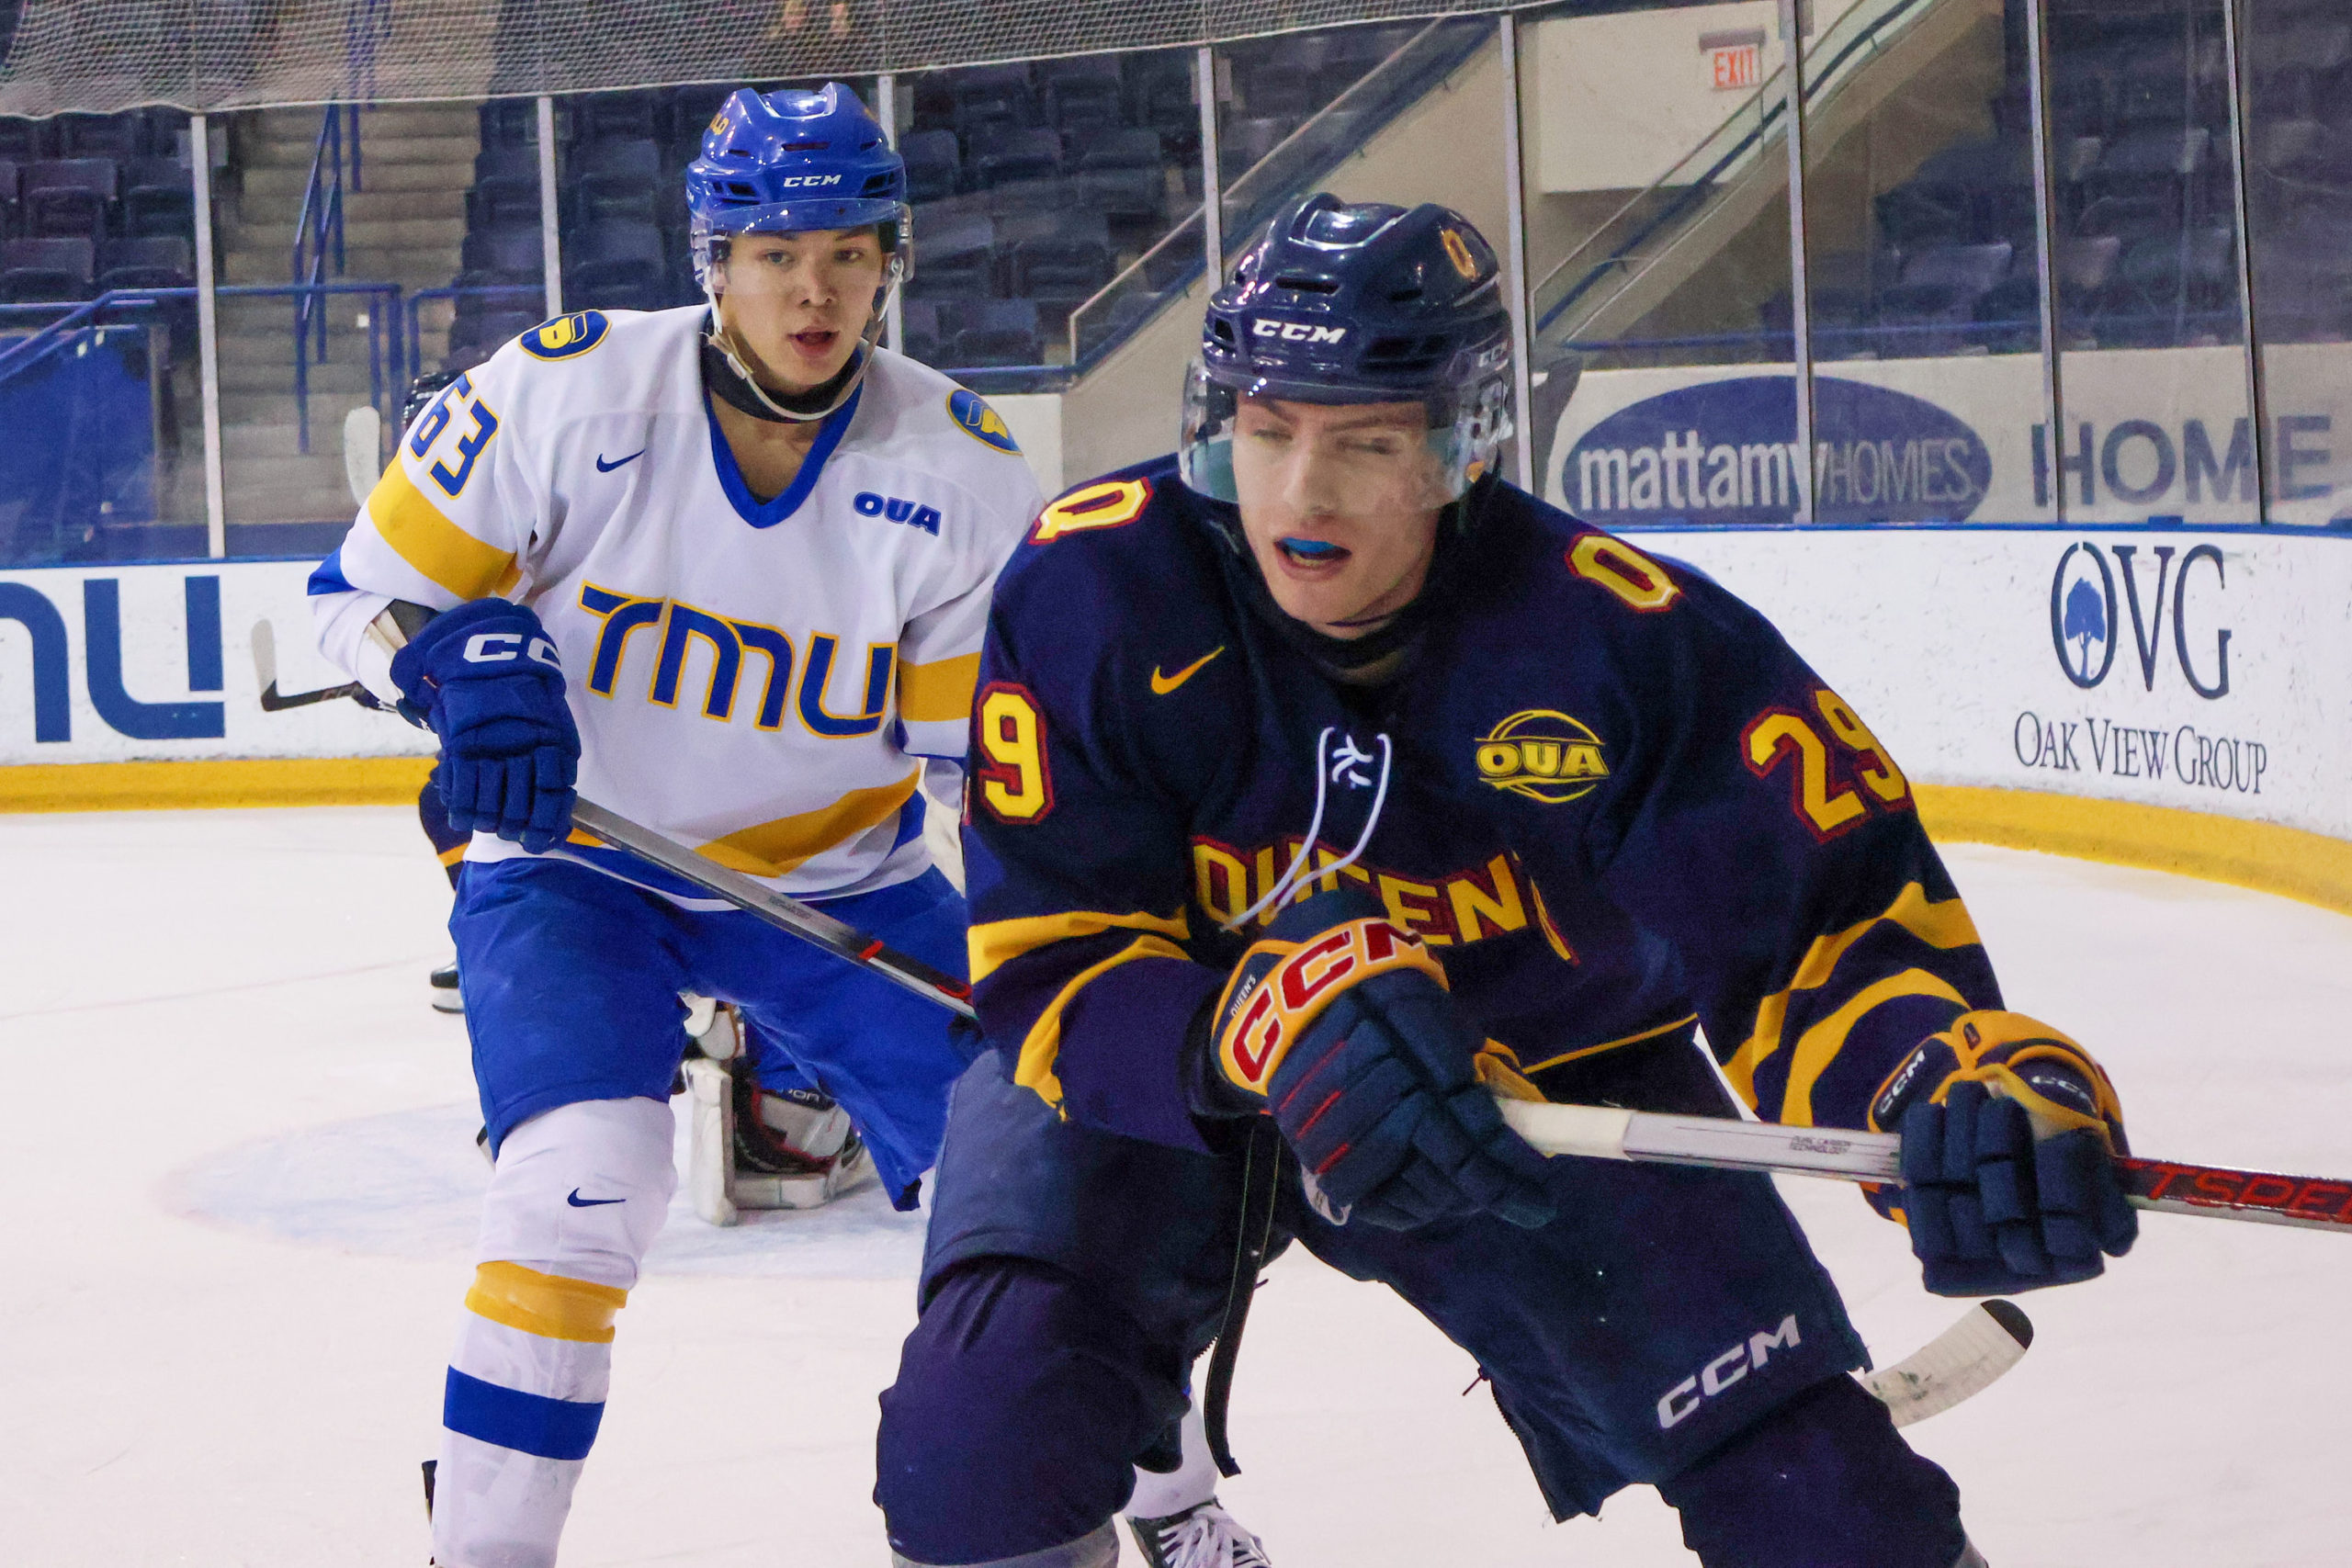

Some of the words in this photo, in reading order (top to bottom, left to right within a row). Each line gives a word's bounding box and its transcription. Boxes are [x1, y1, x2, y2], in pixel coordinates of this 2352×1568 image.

[1713, 48, 1753, 87] EXIT
[784, 174, 842, 188] CCM
[1251, 318, 1347, 344] CCM
[410, 366, 501, 500] 63
[1579, 430, 1827, 511] mattamy
[1827, 437, 1974, 504] HOMES
[2031, 415, 2333, 506] HOME
[853, 491, 942, 536] OUA
[577, 579, 899, 739] TMU
[2051, 541, 2232, 699] OVG
[963, 681, 1056, 825] 9
[1476, 742, 1611, 777] OUA
[1741, 685, 1915, 844] 29
[1880, 1049, 1926, 1114] CCM
[2123, 1158, 2352, 1224] TSPE
[1657, 1314, 1801, 1429] CCM
